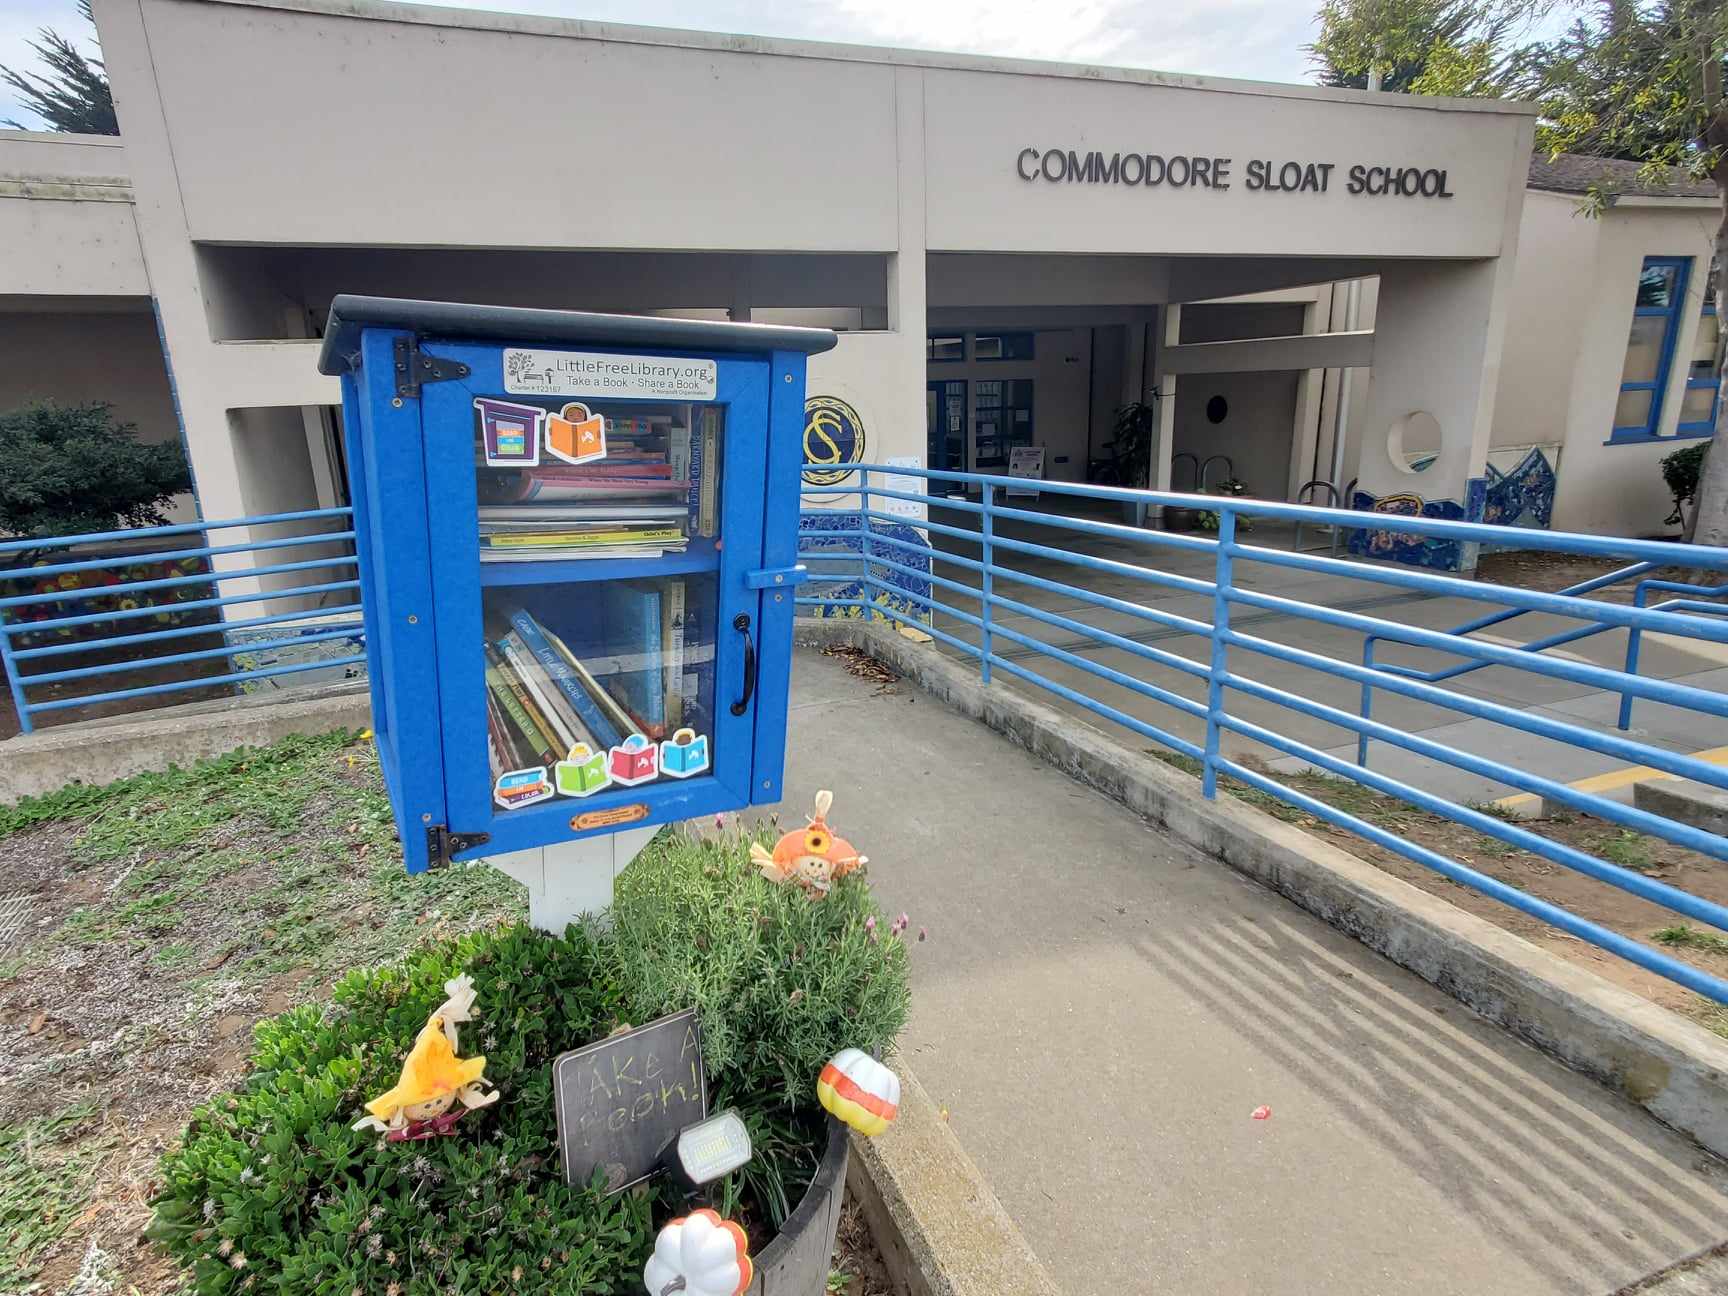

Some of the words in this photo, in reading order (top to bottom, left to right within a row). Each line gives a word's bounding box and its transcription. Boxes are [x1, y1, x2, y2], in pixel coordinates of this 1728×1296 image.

[1017, 147, 1232, 190] COMMODORE
[1245, 159, 1335, 192] SLOAT
[1347, 164, 1453, 198] SCHOOL
[556, 359, 708, 380] LittleFreeLibrary.org
[567, 375, 590, 386] Take
[603, 377, 628, 387] Book
[637, 378, 665, 388] Share
[676, 380, 700, 390] Book
[680, 1025, 699, 1062] A
